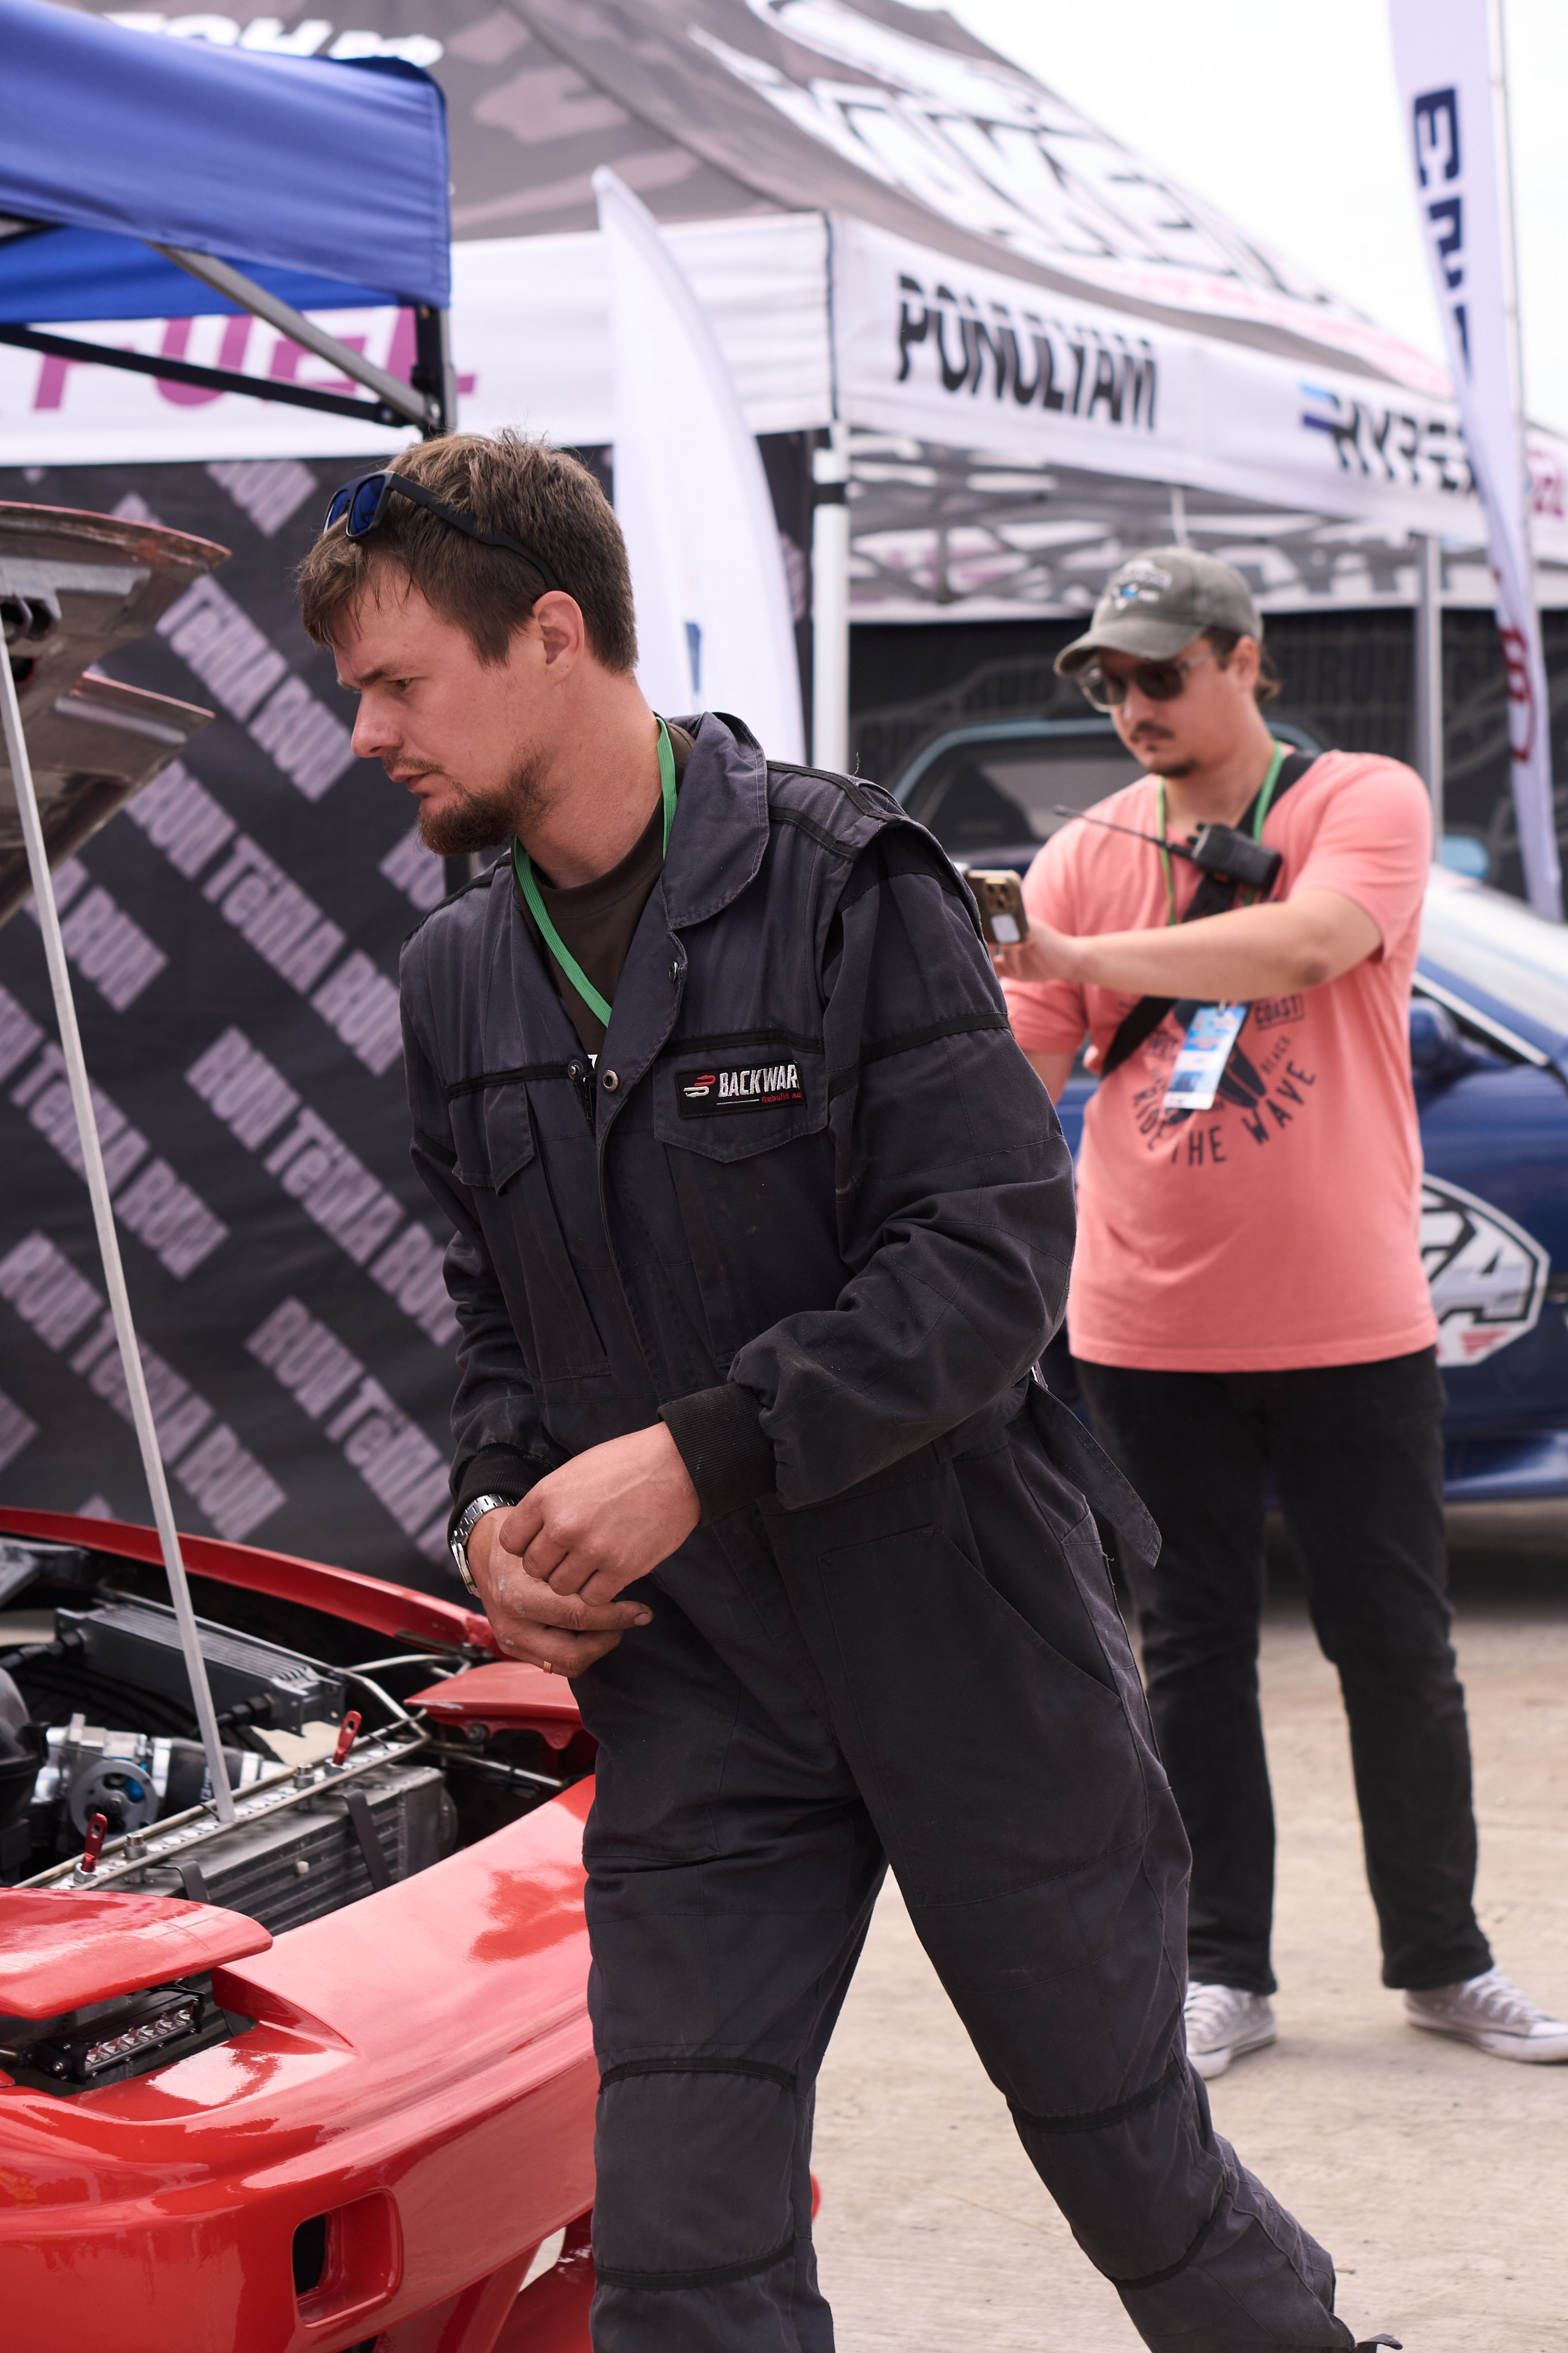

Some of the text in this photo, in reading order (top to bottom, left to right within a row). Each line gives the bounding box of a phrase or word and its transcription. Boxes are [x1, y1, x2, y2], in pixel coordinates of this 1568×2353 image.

[247, 673, 359, 800] RUN
[124, 758, 238, 877] RUN
[311, 950, 404, 1076] RUN
[380, 825, 445, 910] RU
[60, 886, 168, 1011] RUN
[184, 1027, 301, 1152] RUN
[718, 1064, 800, 1097] BACKWAR
[761, 1092, 790, 1103] Rebuild
[1170, 1125, 1226, 1165] THE
[1241, 1059, 1317, 1146] WAVE
[112, 1157, 230, 1280] RUN
[0, 1229, 102, 1351] RUN
[176, 1422, 288, 1544] RUN
[243, 1295, 365, 1420] RUN
